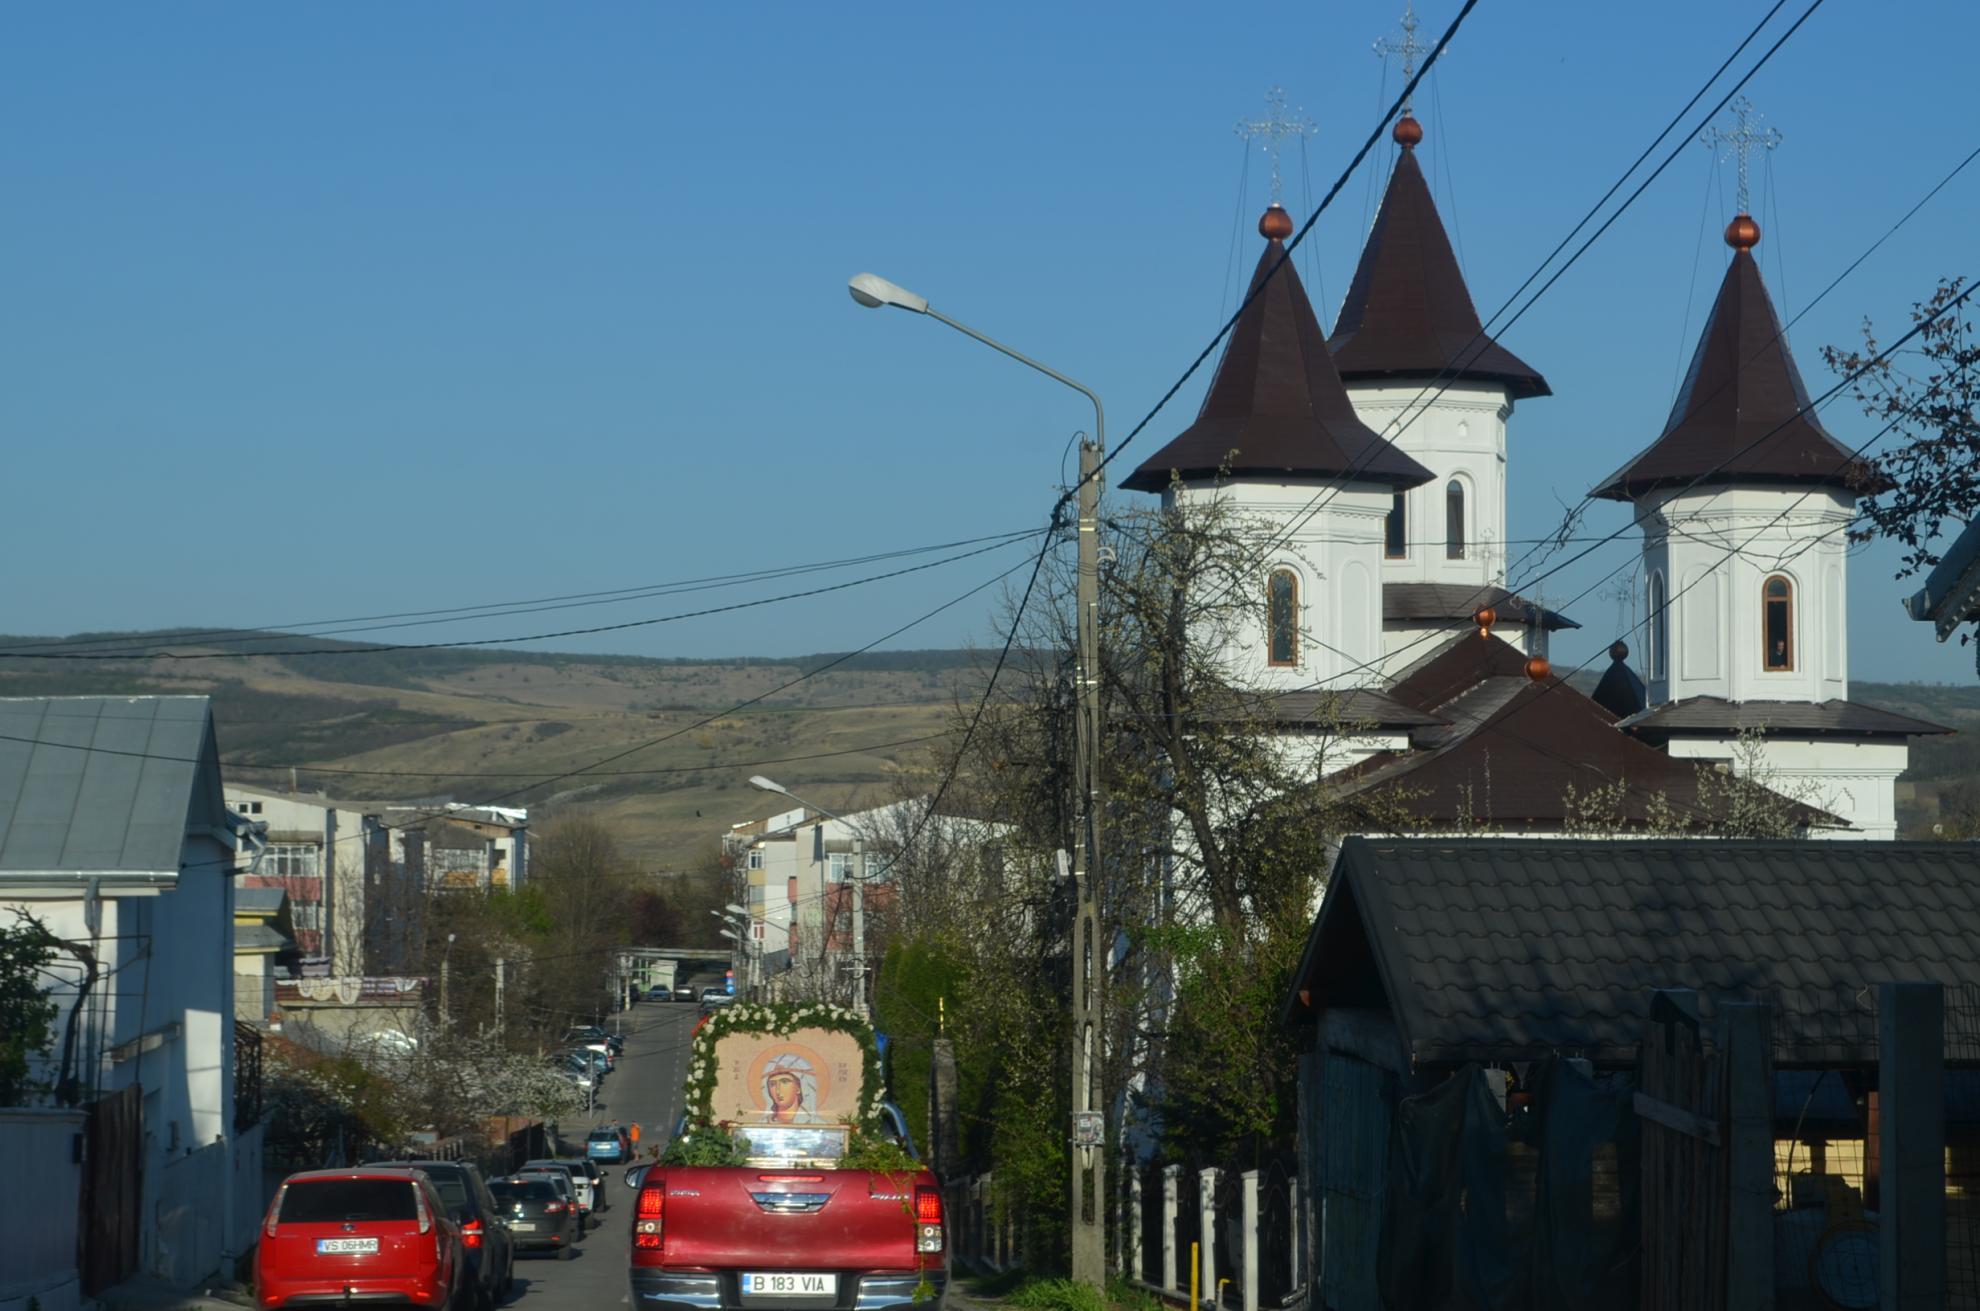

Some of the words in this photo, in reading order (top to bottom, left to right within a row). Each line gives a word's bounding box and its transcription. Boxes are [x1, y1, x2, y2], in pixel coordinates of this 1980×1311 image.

[324, 1240, 339, 1251] VS
[753, 1276, 765, 1291] B
[771, 1276, 795, 1291] 183
[802, 1276, 825, 1292] VIA
